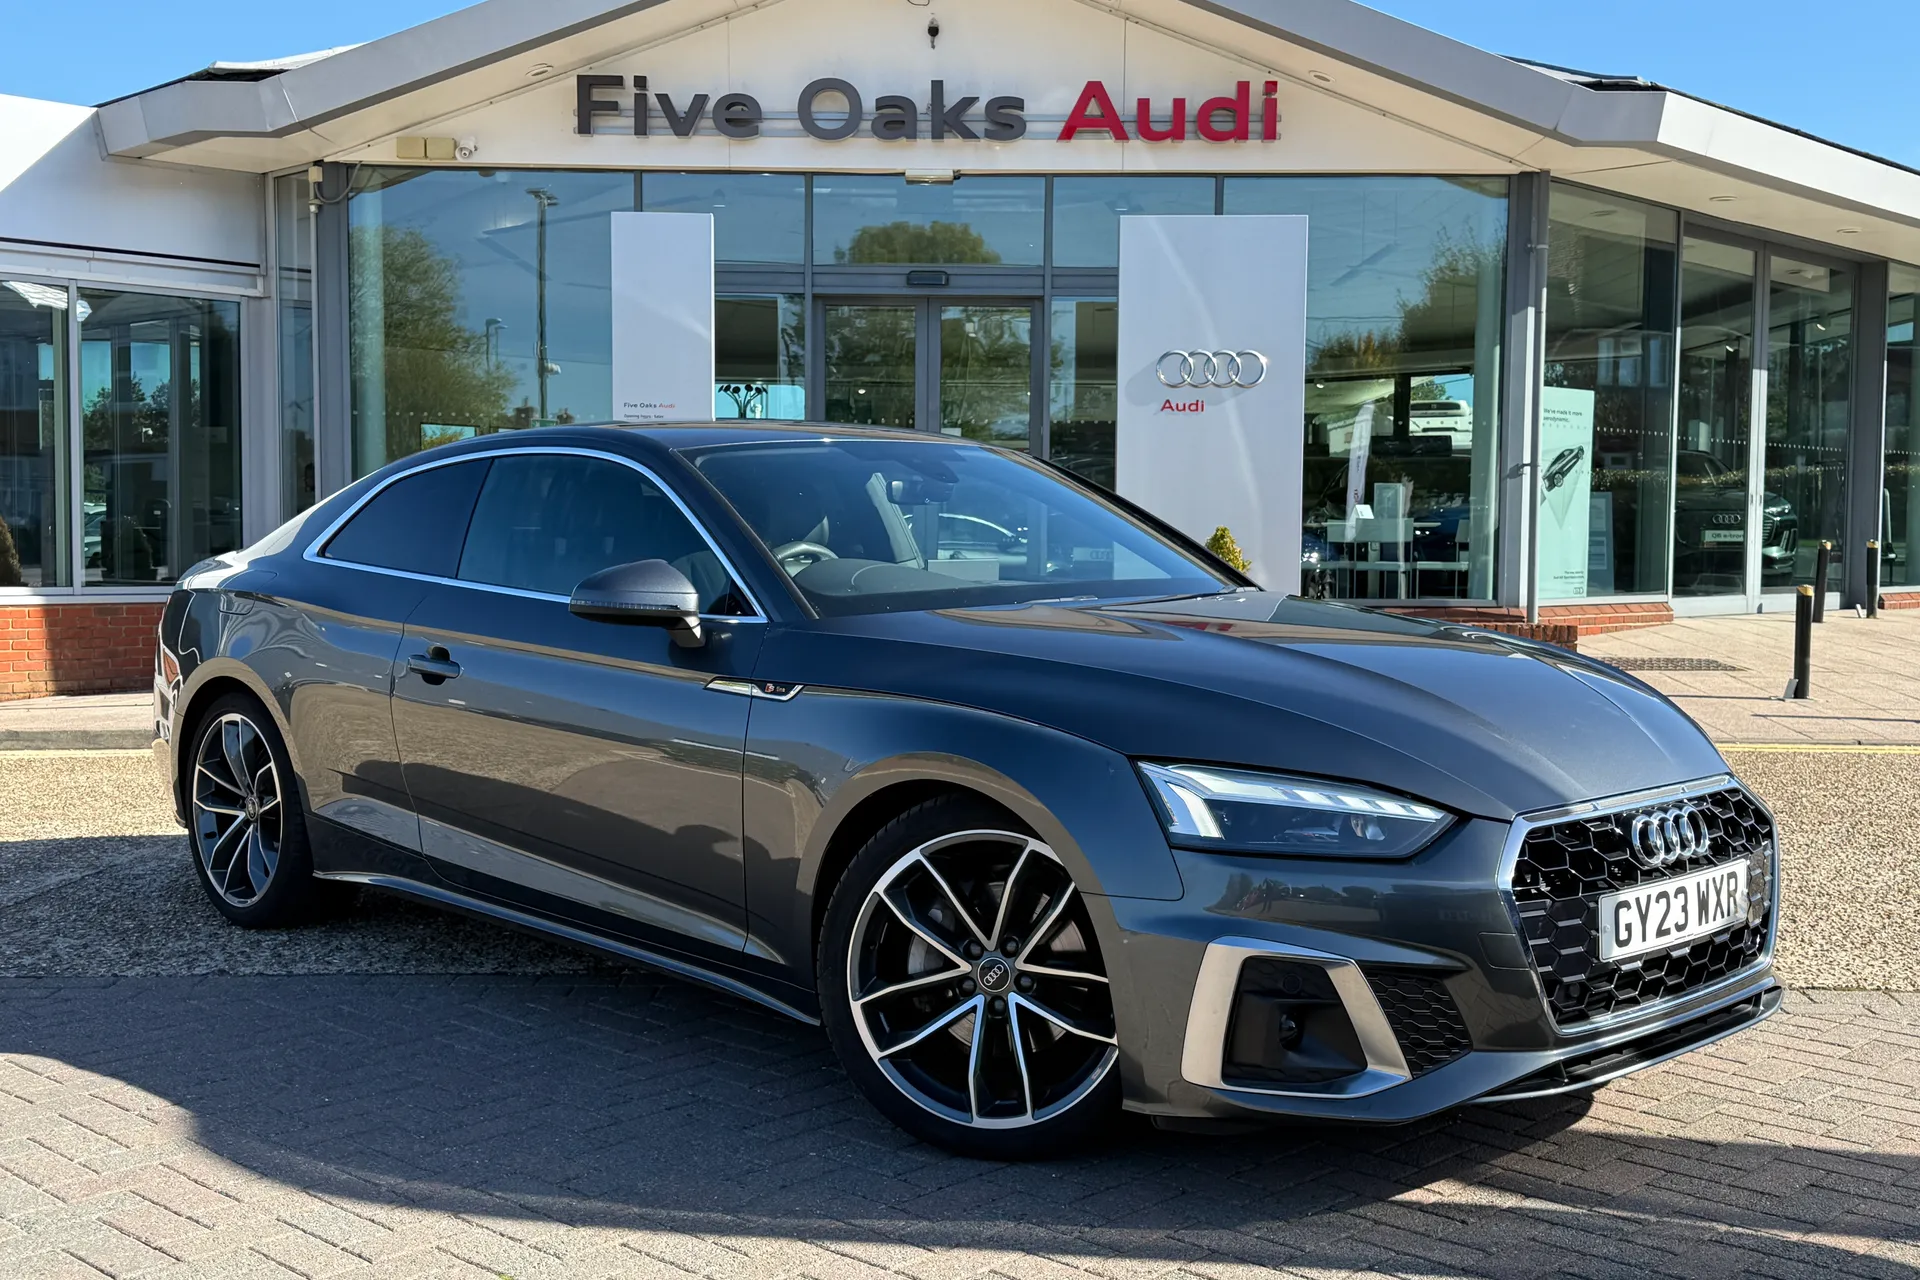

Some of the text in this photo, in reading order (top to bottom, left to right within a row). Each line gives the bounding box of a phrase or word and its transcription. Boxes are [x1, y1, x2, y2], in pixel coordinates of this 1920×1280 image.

[577, 75, 1279, 142] Five Oaks Audi
[1161, 399, 1205, 412] Audi
[1614, 870, 1739, 948] GY23 WXR
